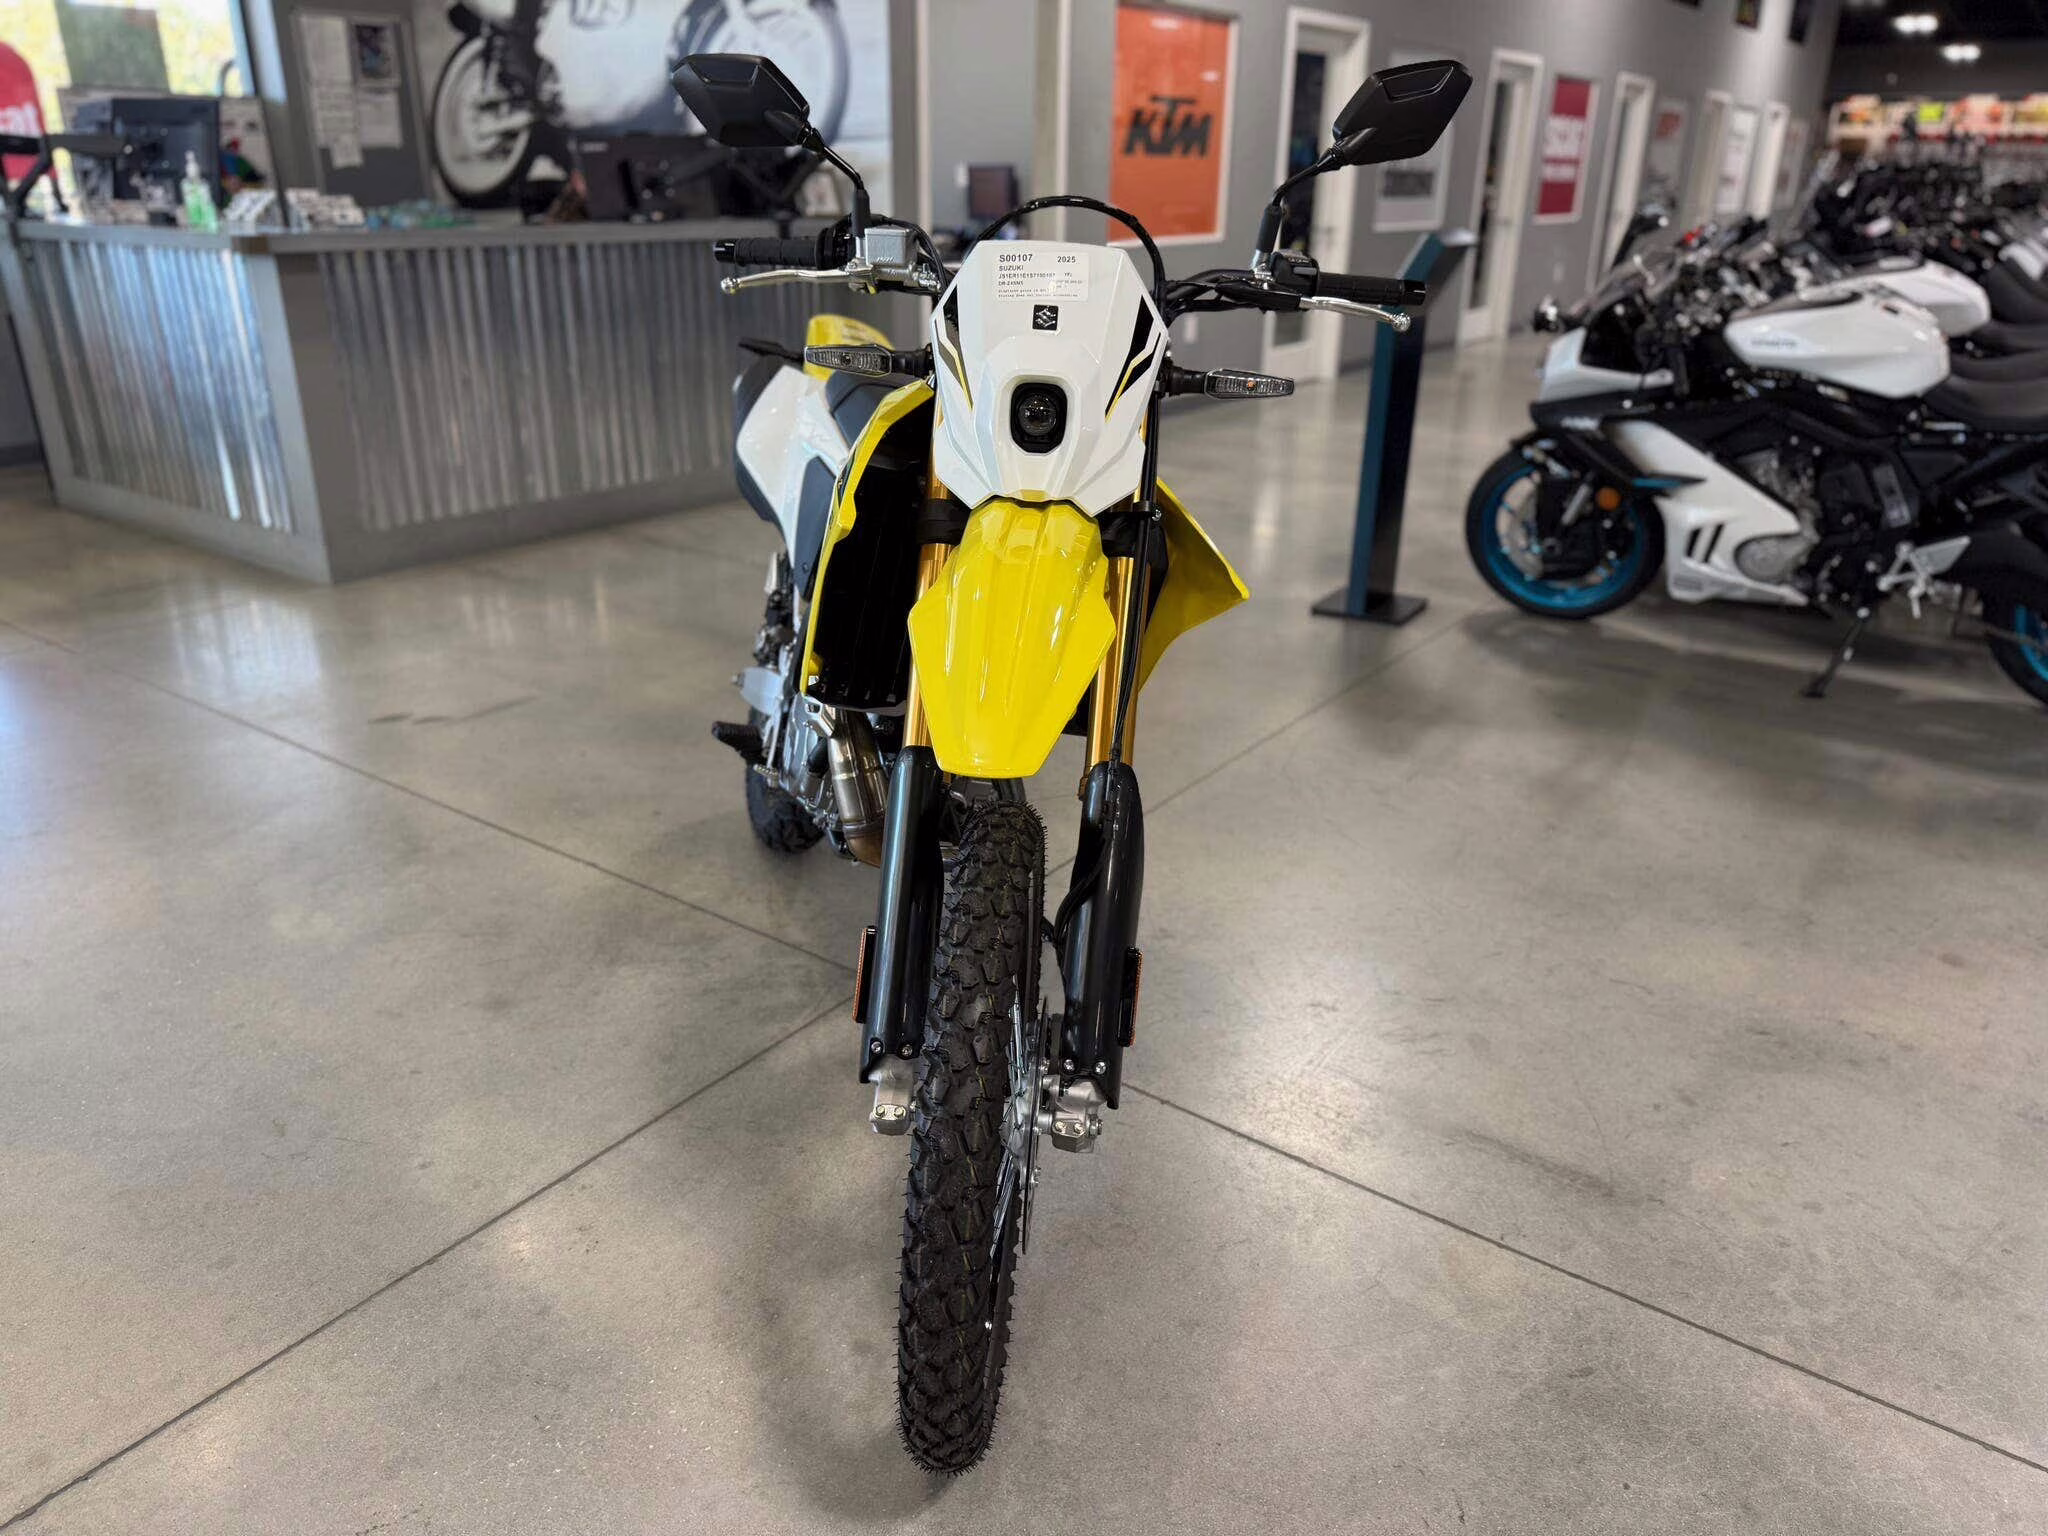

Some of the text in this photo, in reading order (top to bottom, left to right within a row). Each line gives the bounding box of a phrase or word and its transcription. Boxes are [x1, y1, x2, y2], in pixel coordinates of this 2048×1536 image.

[1124, 94, 1214, 157] KTM
[999, 254, 1076, 263] S00107 2025
